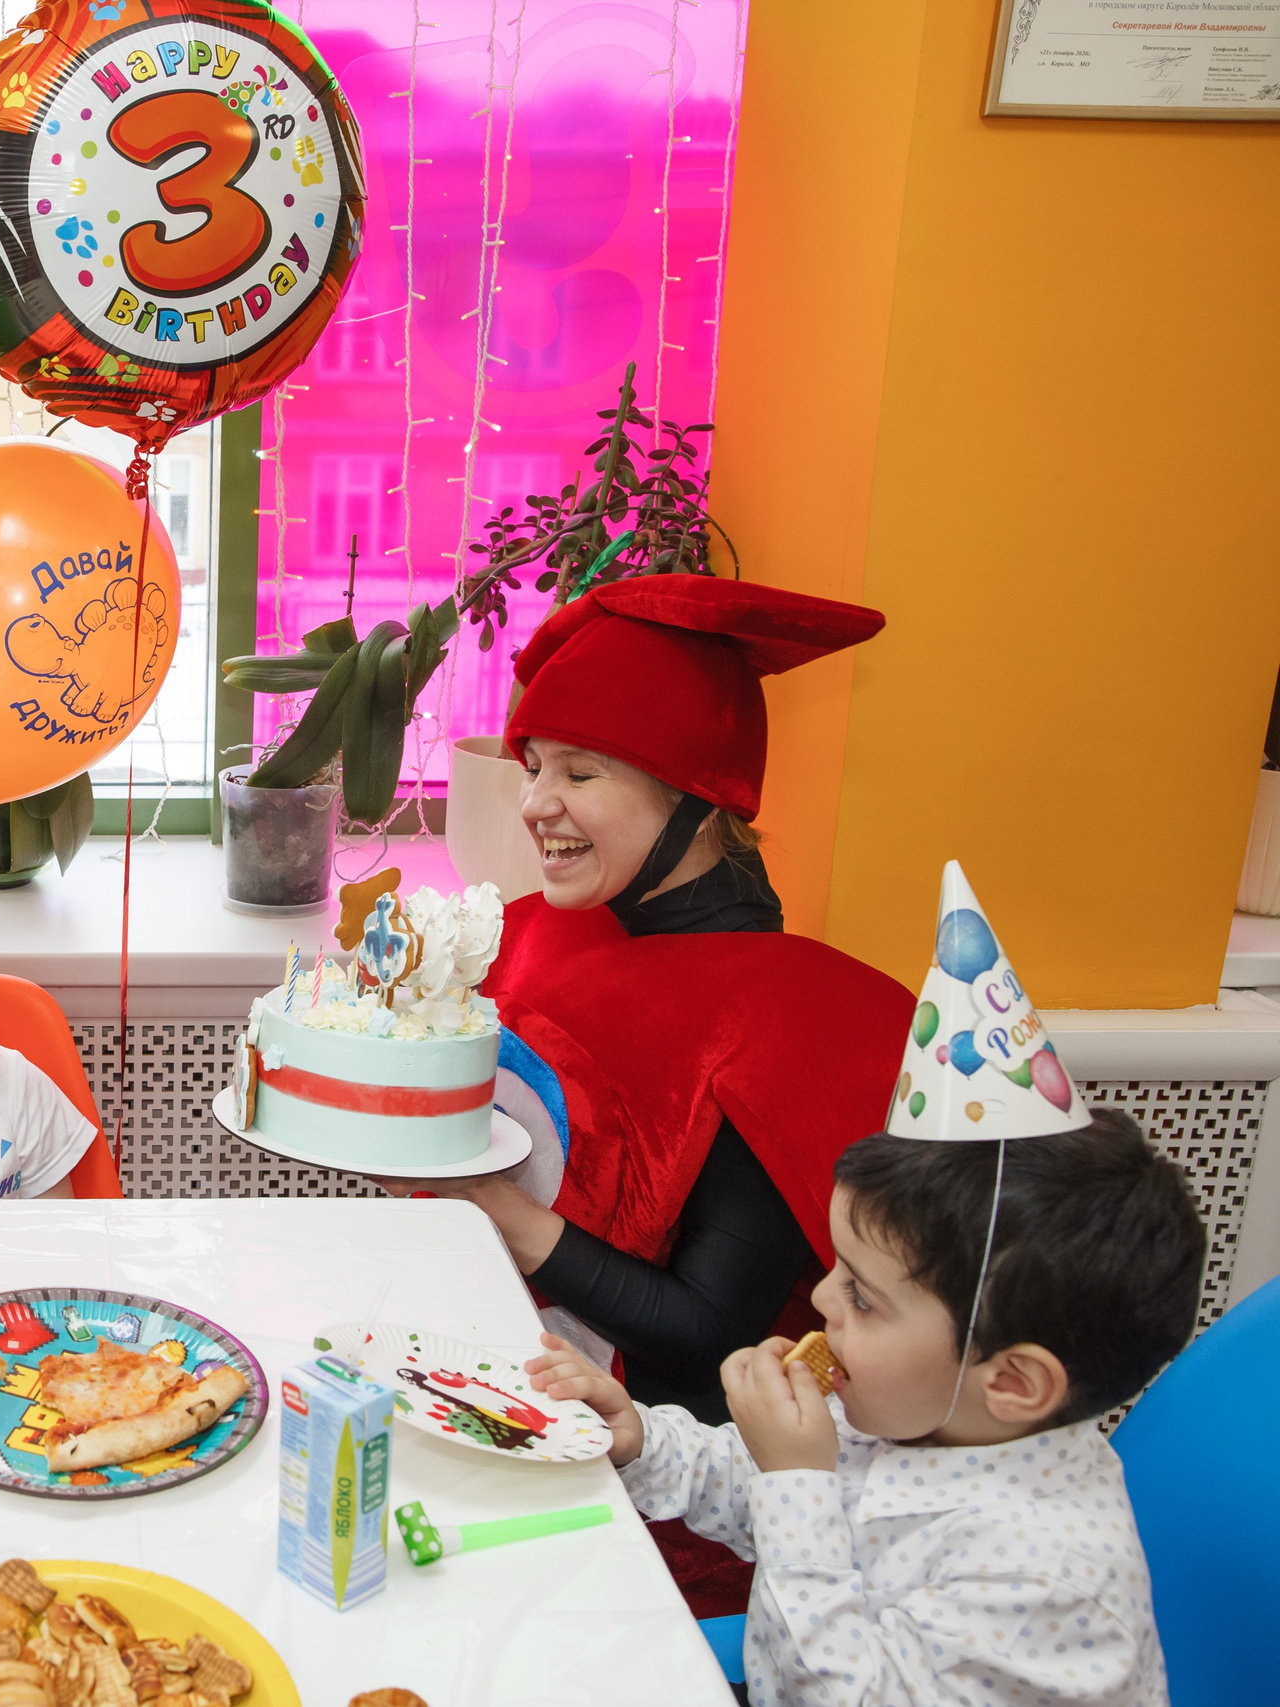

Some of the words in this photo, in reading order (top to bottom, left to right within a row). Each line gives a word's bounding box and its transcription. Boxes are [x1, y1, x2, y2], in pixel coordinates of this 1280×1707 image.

[1095, 1, 1135, 10] городском
[1137, 2, 1164, 11] округе
[1166, 1, 1200, 11] Королёв
[1202, 3, 1251, 11] Московской
[1112, 20, 1172, 31] Секретаревой
[1174, 22, 1198, 31] Юлии
[1199, 22, 1267, 33] Владимировны
[106, 88, 273, 299] 3
[262, 113, 296, 140] RD
[31, 540, 132, 605] Давай
[334, 1476, 353, 1539] ЯБЛОКО
